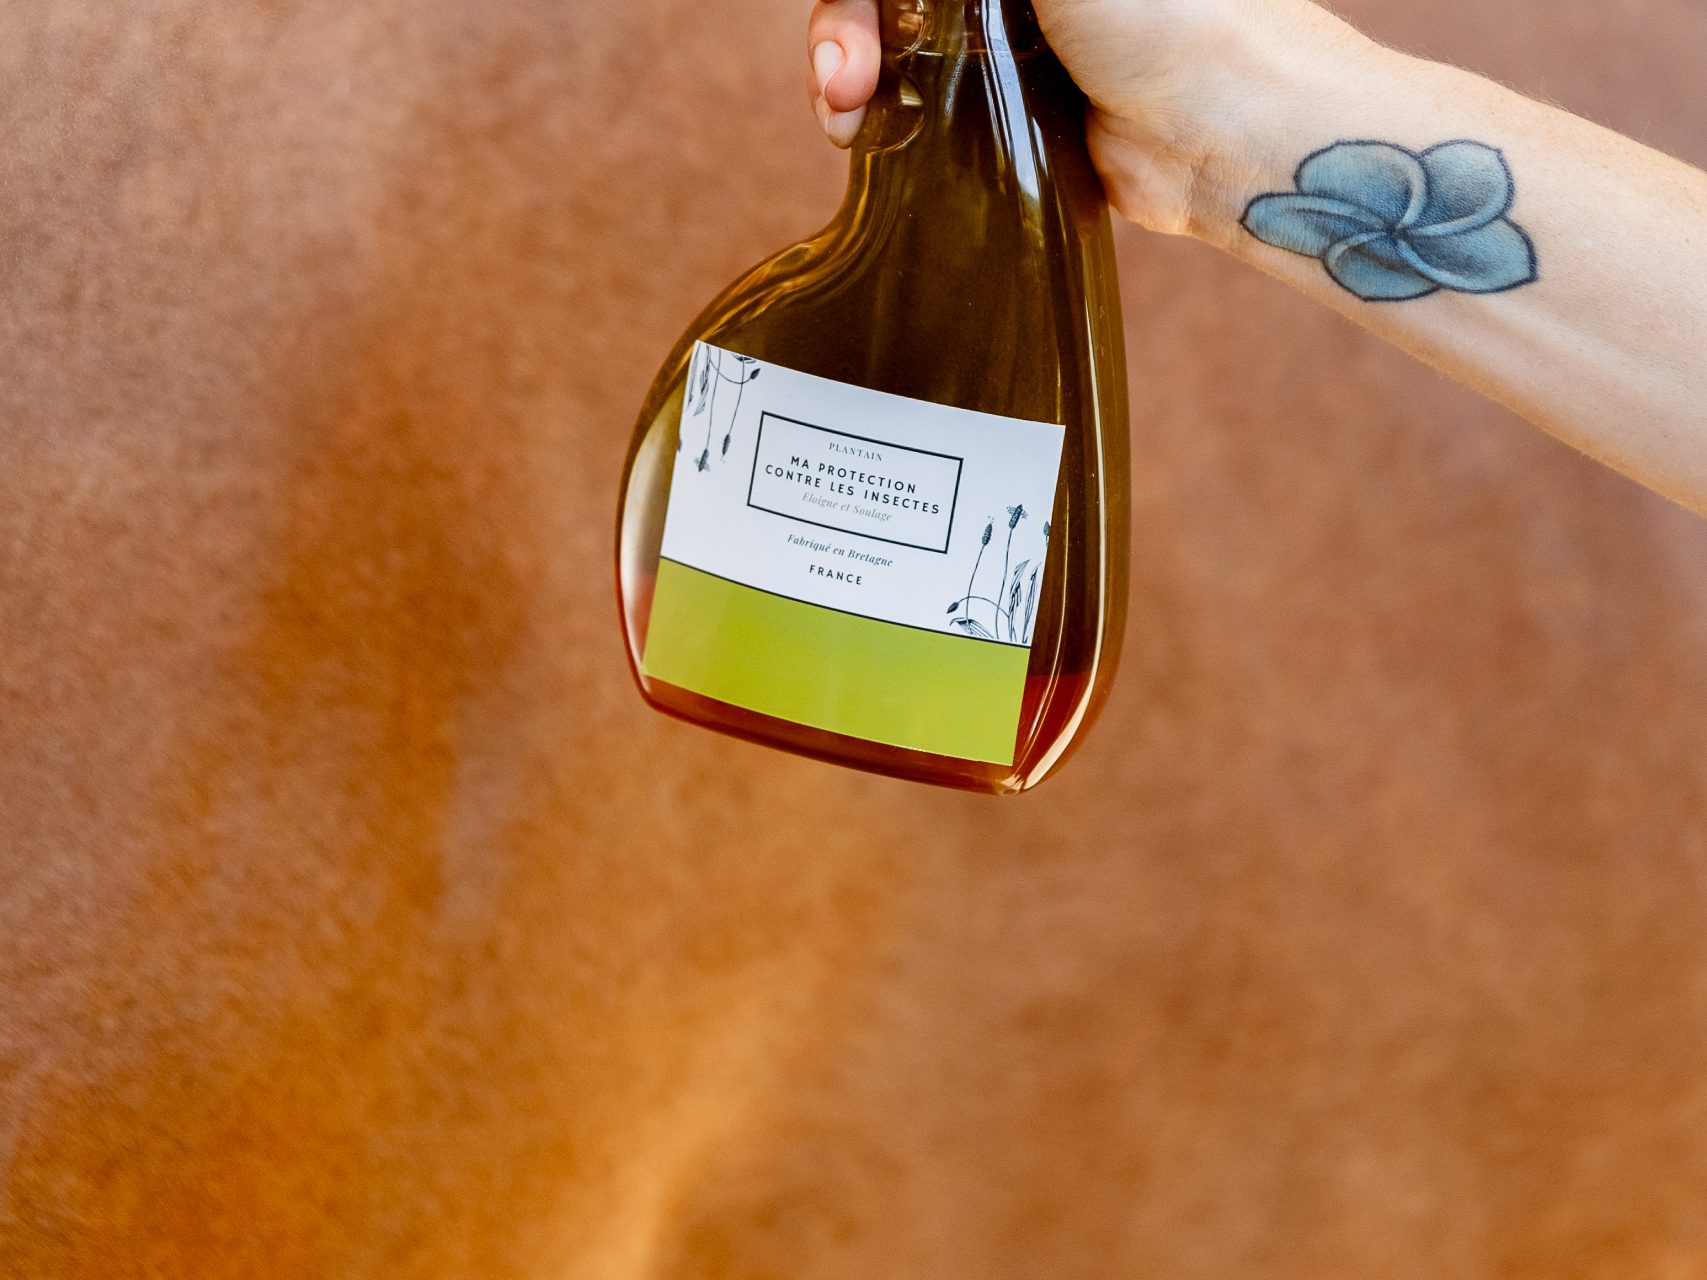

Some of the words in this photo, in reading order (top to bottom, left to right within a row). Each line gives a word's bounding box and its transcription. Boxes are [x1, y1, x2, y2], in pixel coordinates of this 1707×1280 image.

[829, 442, 883, 461] PLANTAIN
[791, 455, 809, 469] MA
[819, 463, 916, 494] PROTECTION
[766, 464, 821, 488] CONTRE
[830, 482, 854, 496] LES
[864, 490, 939, 514] INSECTES
[841, 501, 851, 512] et
[853, 504, 892, 521] Soulage
[787, 534, 831, 553] Fabriqué
[833, 546, 845, 556] en
[848, 549, 893, 567] Bretagne
[809, 565, 862, 585] FRANCE
